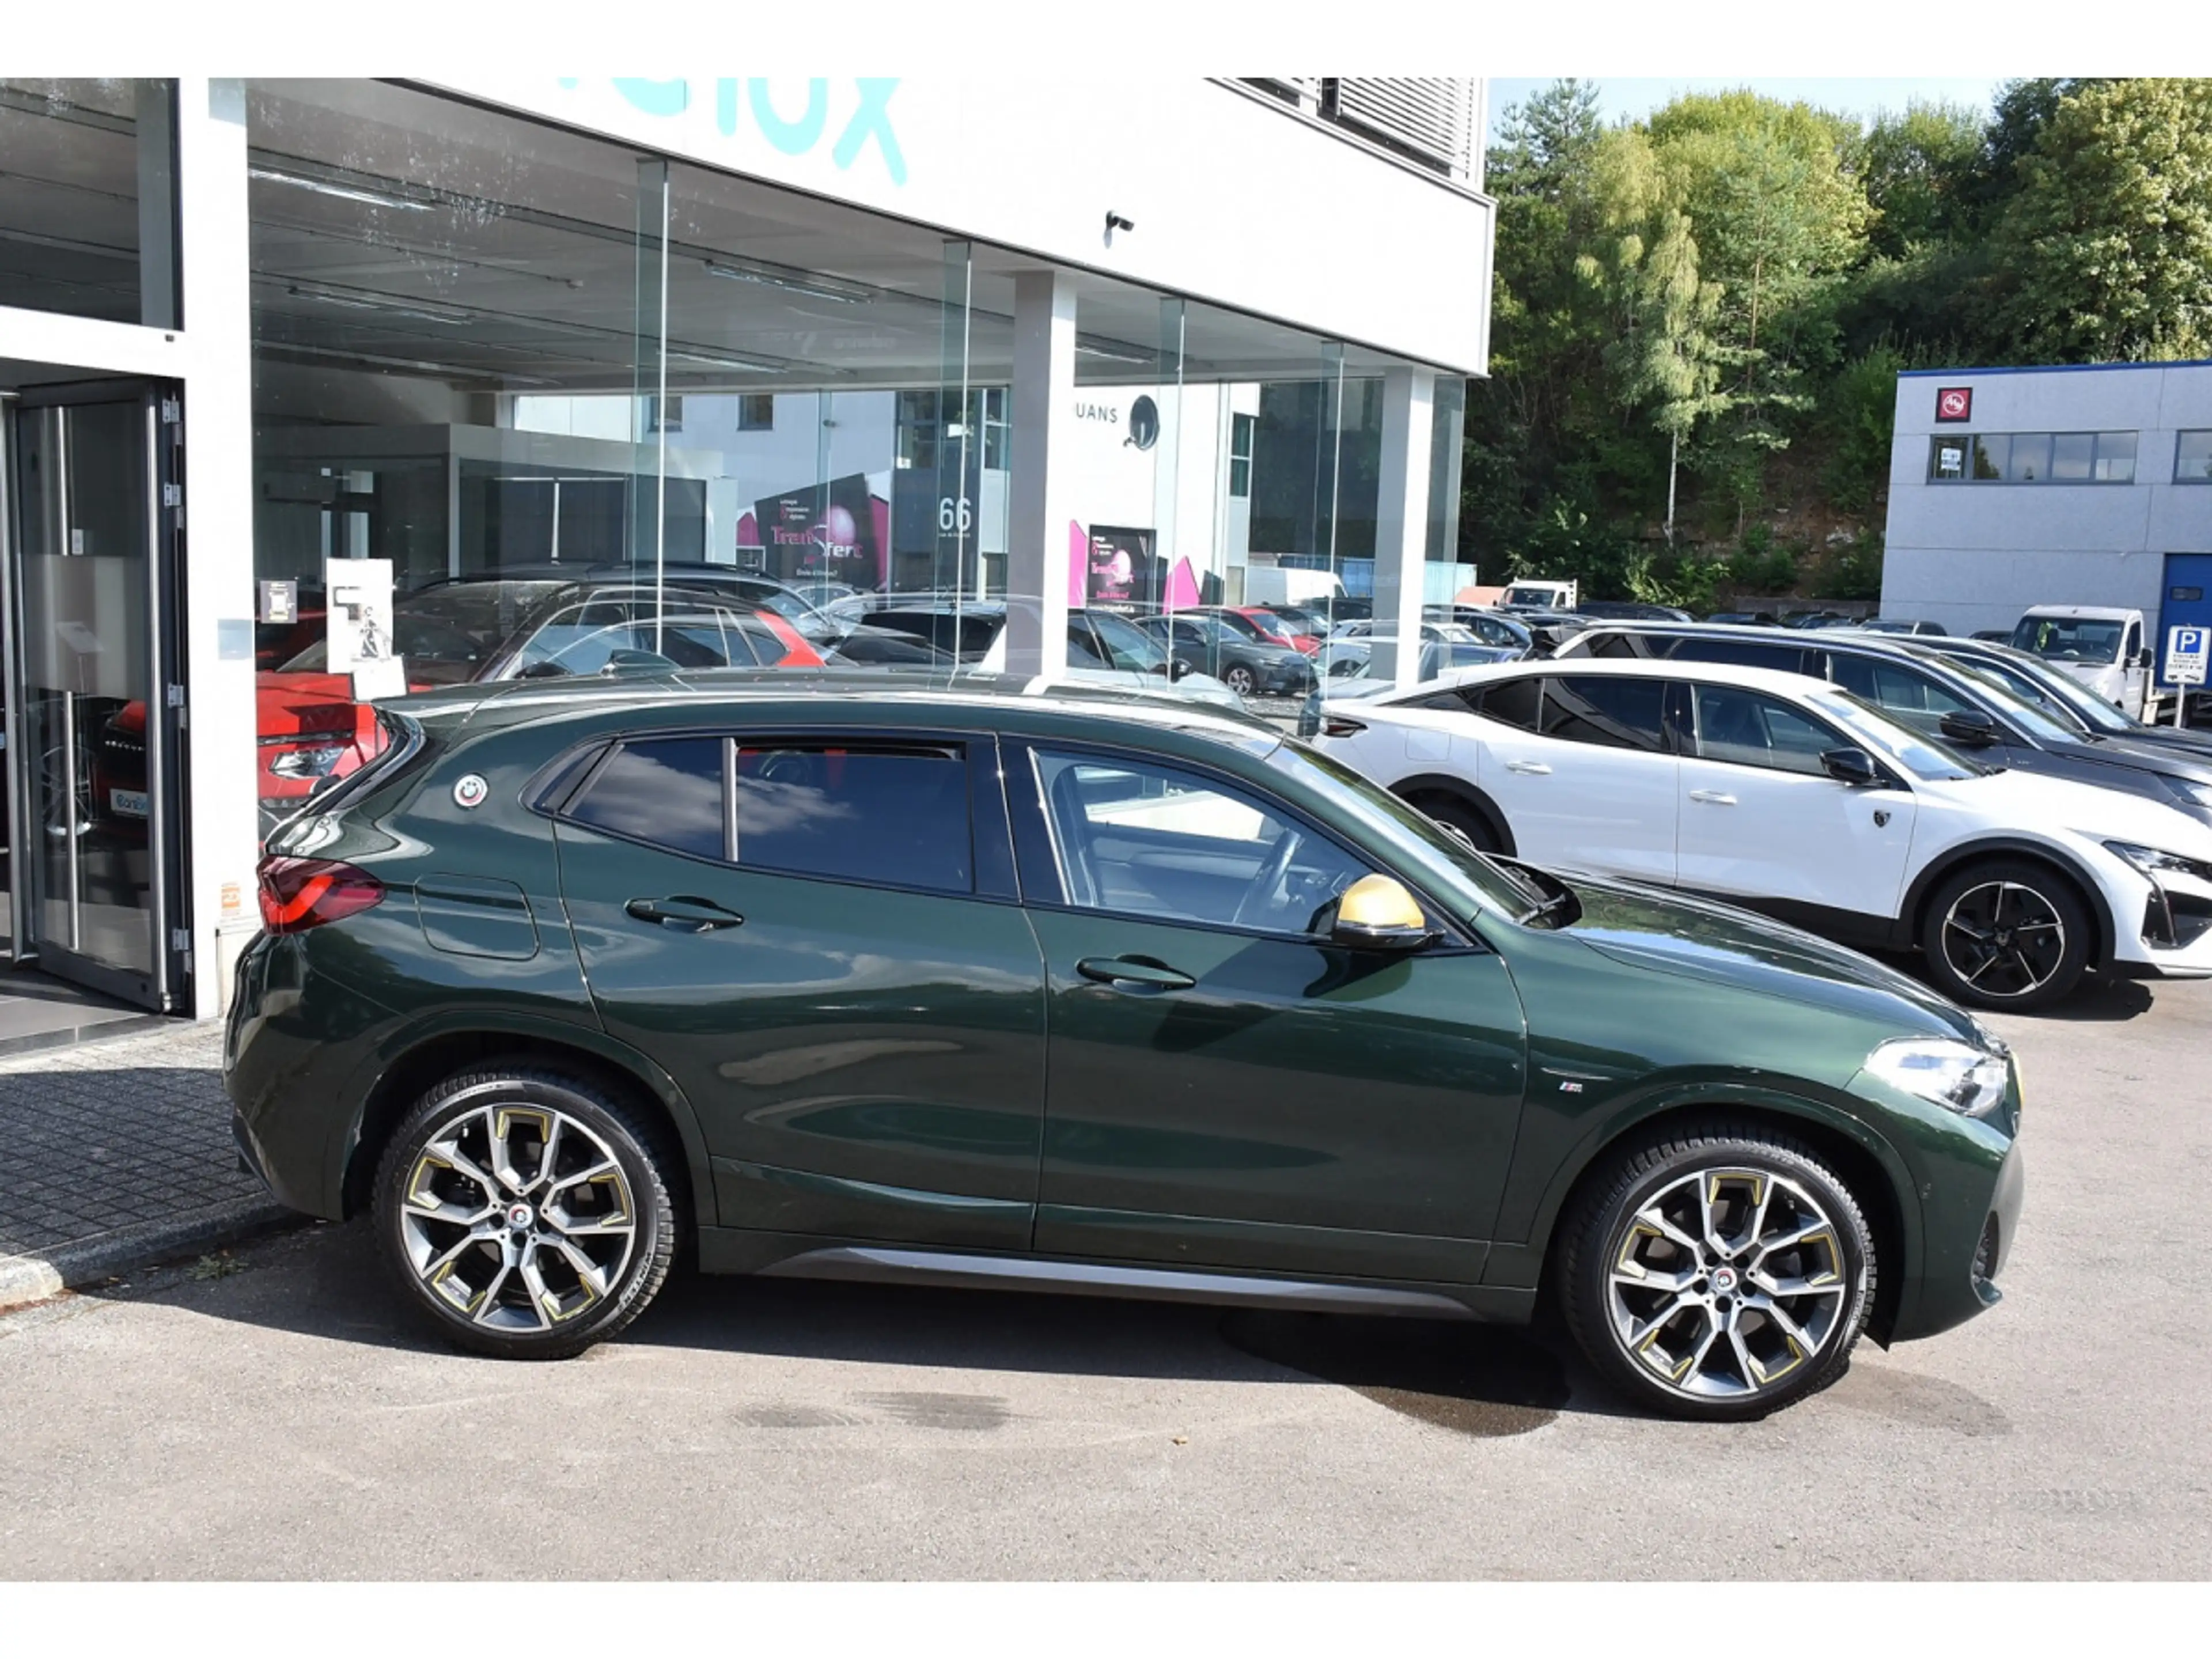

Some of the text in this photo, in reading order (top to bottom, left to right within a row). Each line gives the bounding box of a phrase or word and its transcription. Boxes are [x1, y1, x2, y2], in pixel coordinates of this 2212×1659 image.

[1075, 403, 1118, 423] UANS
[940, 497, 971, 531] 66
[2180, 632, 2196, 652] P
